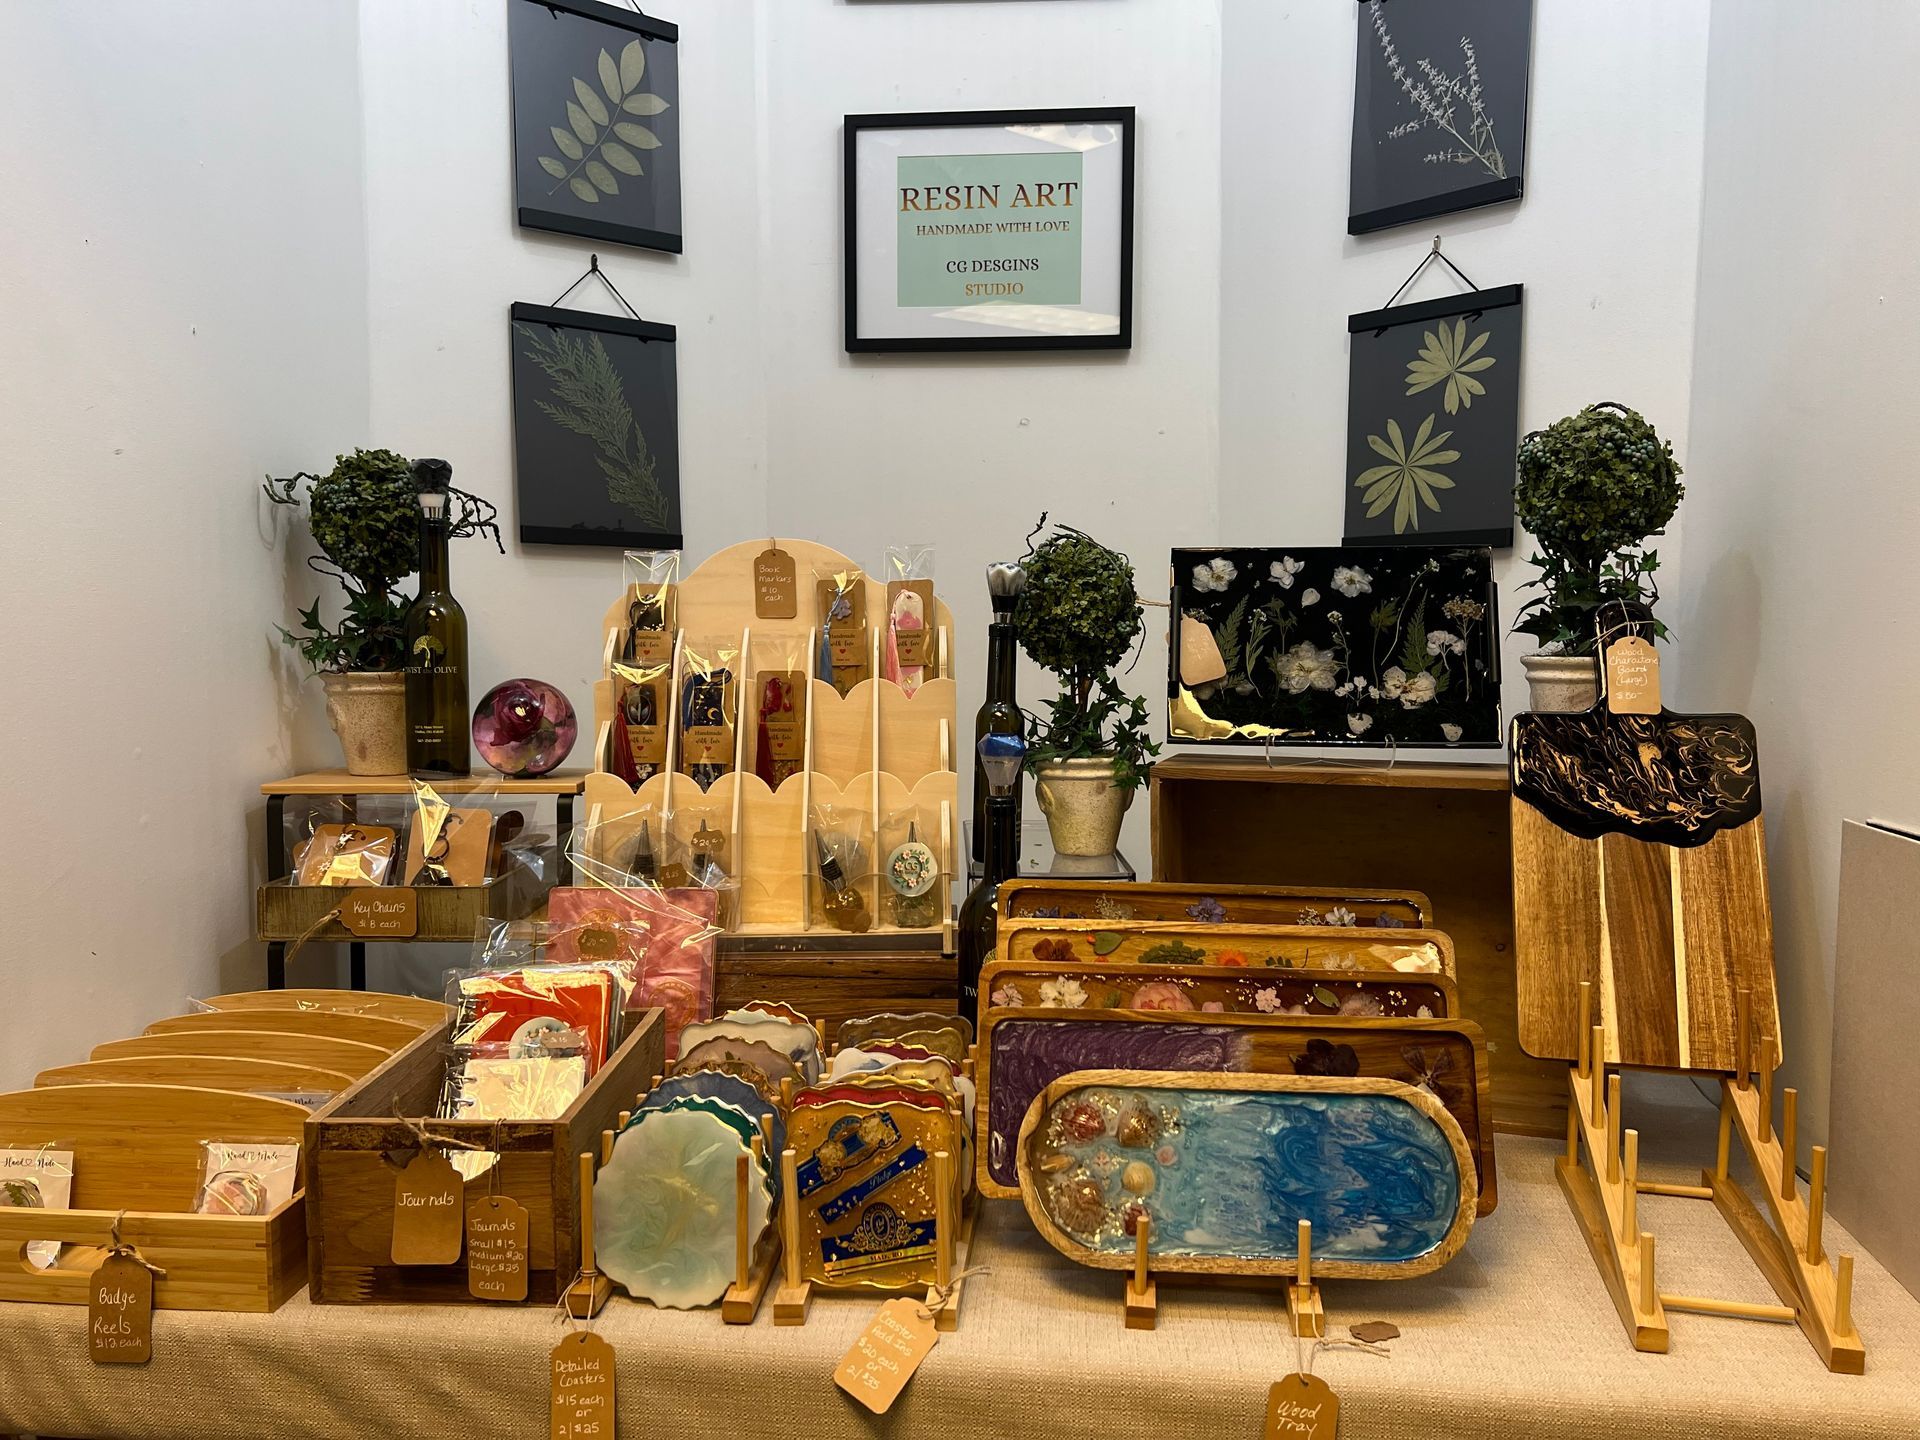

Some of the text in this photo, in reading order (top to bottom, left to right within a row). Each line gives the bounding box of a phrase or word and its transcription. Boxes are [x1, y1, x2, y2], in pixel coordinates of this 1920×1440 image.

[900, 182, 1078, 212] RESIN ART
[916, 220, 1070, 236] HANDMADE WITH LOVE
[946, 258, 1039, 273] CG DESGINS
[965, 282, 1024, 296] STUDIO
[759, 564, 780, 573] Book
[764, 594, 784, 602] each
[434, 666, 459, 674] OLIVE
[353, 901, 406, 918] Key Chains
[380, 920, 401, 928] each
[399, 1192, 455, 1207] Journals
[469, 1218, 516, 1232] Journals
[497, 1239, 516, 1249] $15
[471, 1260, 498, 1276] Large
[479, 1281, 505, 1292] each
[99, 1287, 137, 1311] Badge
[93, 1315, 131, 1335] Reels
[879, 1311, 917, 1340] Coaster
[119, 1337, 142, 1348] each
[555, 1357, 600, 1373] Detailed
[865, 1361, 882, 1372] or
[877, 1356, 900, 1375] each
[560, 1373, 606, 1388] Coasters
[555, 1393, 604, 1407] $15 each
[575, 1408, 593, 1418] or
[1277, 1401, 1322, 1420] Wood
[1277, 1416, 1318, 1440] Tray
